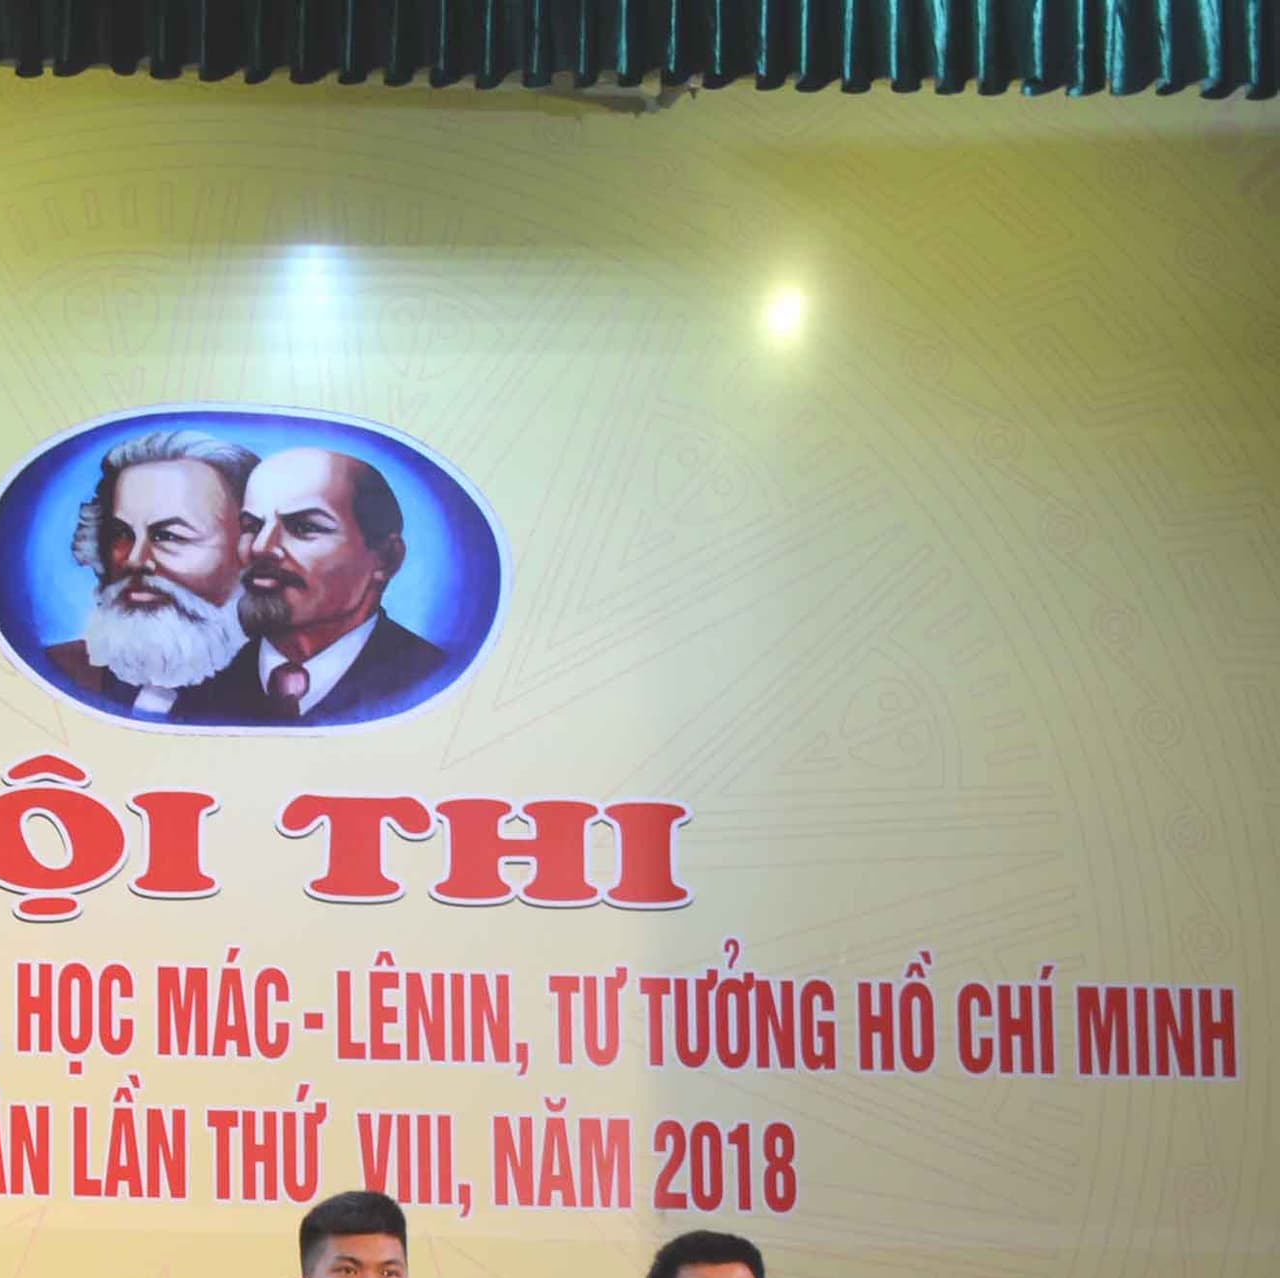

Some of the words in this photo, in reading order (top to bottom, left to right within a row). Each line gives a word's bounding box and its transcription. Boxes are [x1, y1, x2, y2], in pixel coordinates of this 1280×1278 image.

[280, 793, 688, 904] THI
[16, 962, 135, 1077] HỌC
[549, 966, 628, 1066] TƯ
[639, 939, 837, 1070] TƯỞNG
[858, 951, 935, 1072] HỒ
[958, 965, 1054, 1074] CHÍ
[1078, 987, 1235, 1076] MINH
[72, 1074, 188, 1200] LẦN
[207, 1083, 328, 1204] THỨ
[357, 1112, 472, 1218] VIII,
[493, 1098, 632, 1209] NĂM
[654, 1120, 797, 1212] 2018
